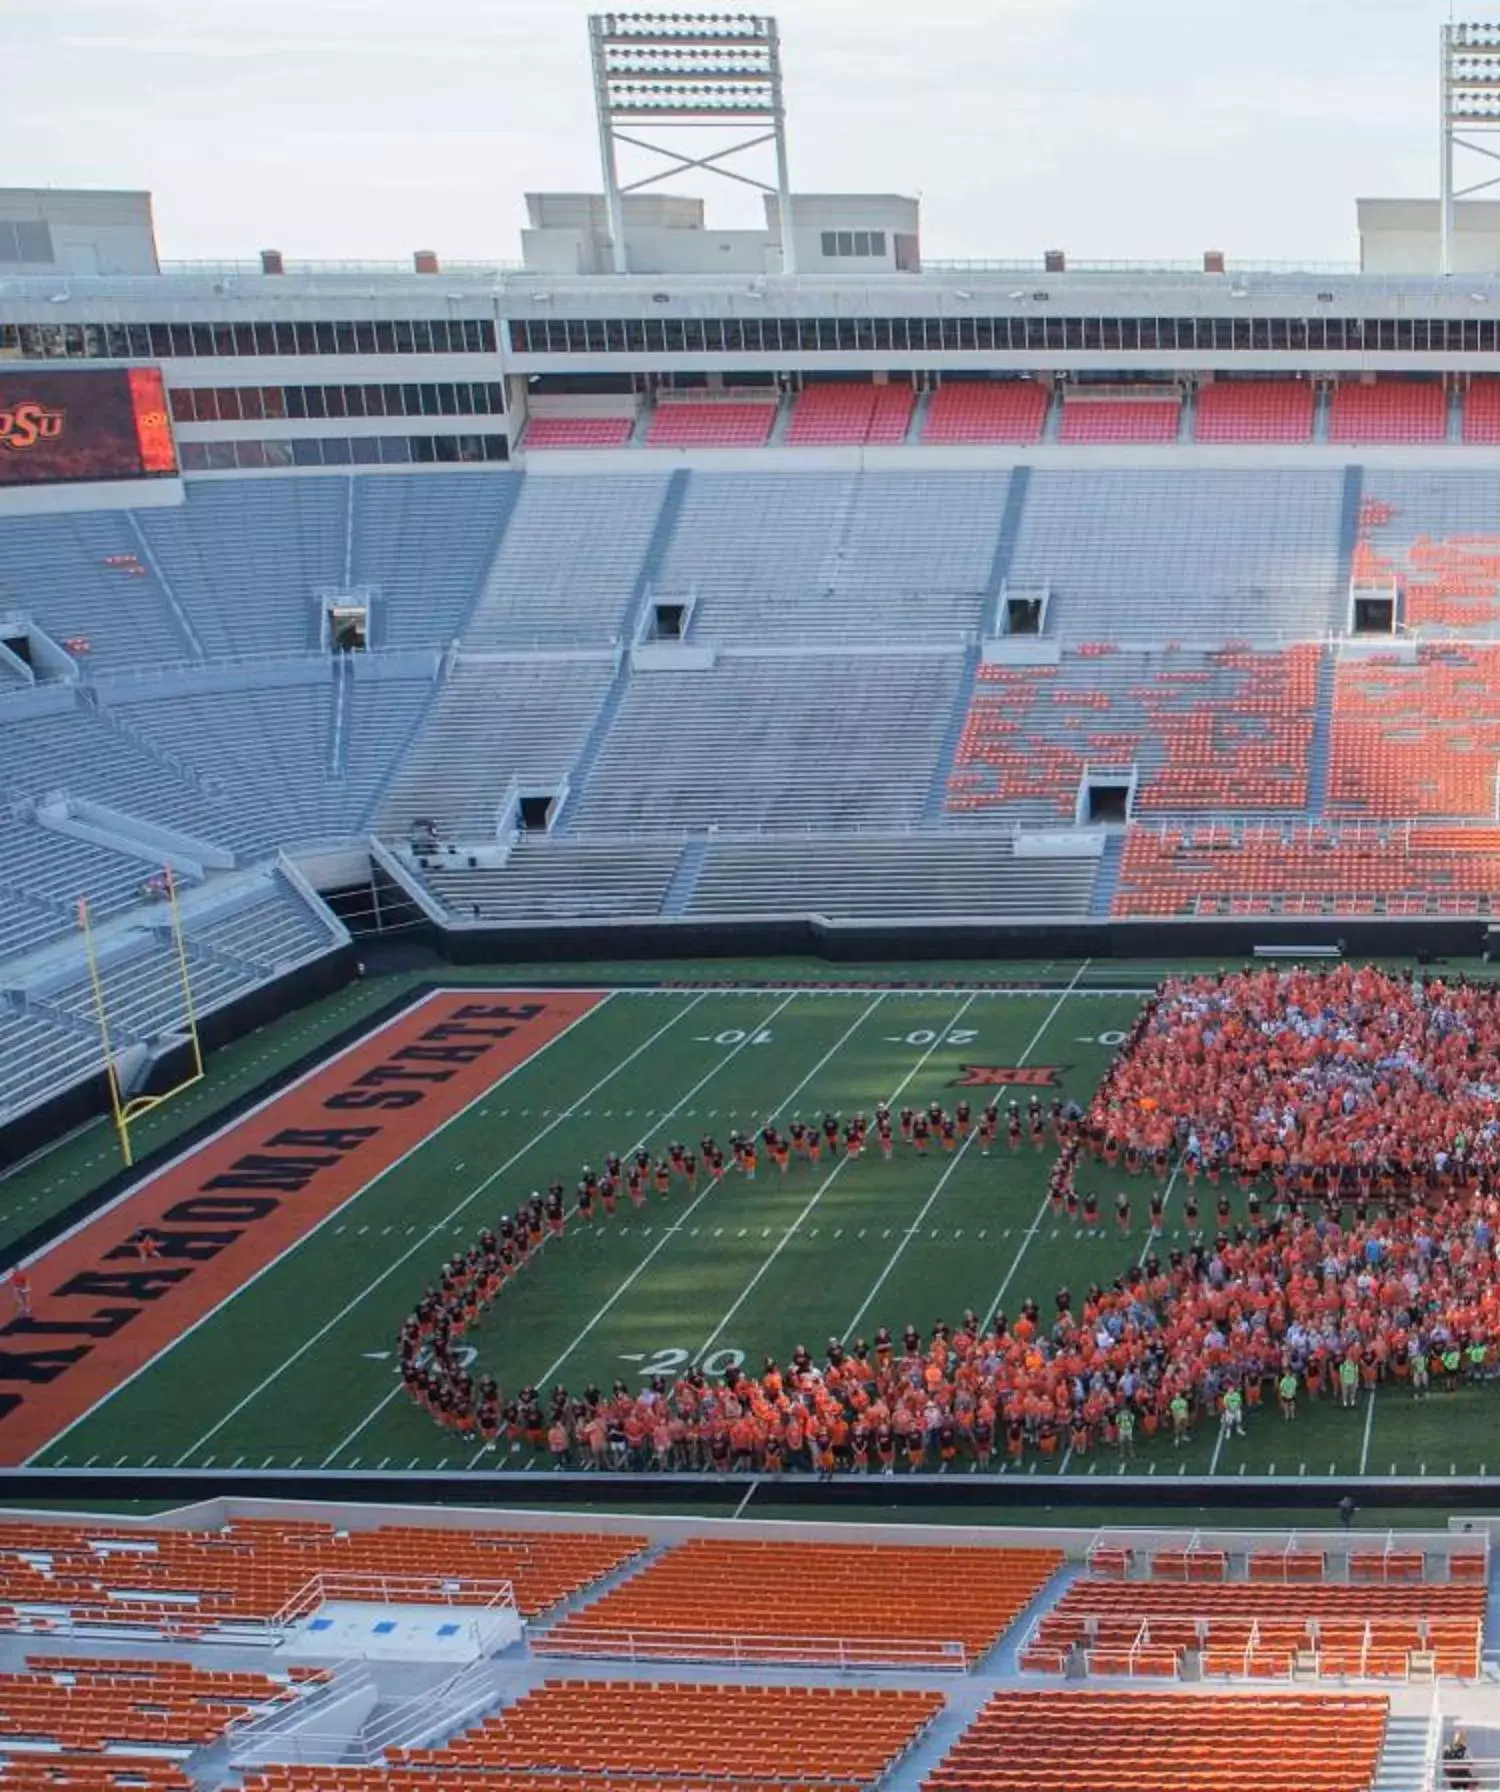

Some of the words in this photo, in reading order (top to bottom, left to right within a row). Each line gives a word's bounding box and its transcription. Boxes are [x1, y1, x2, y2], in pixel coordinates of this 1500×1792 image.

[0, 1126, 382, 1420] KLAHOMA
[324, 1003, 546, 1109] STATE
[639, 1347, 746, 1376] 20
